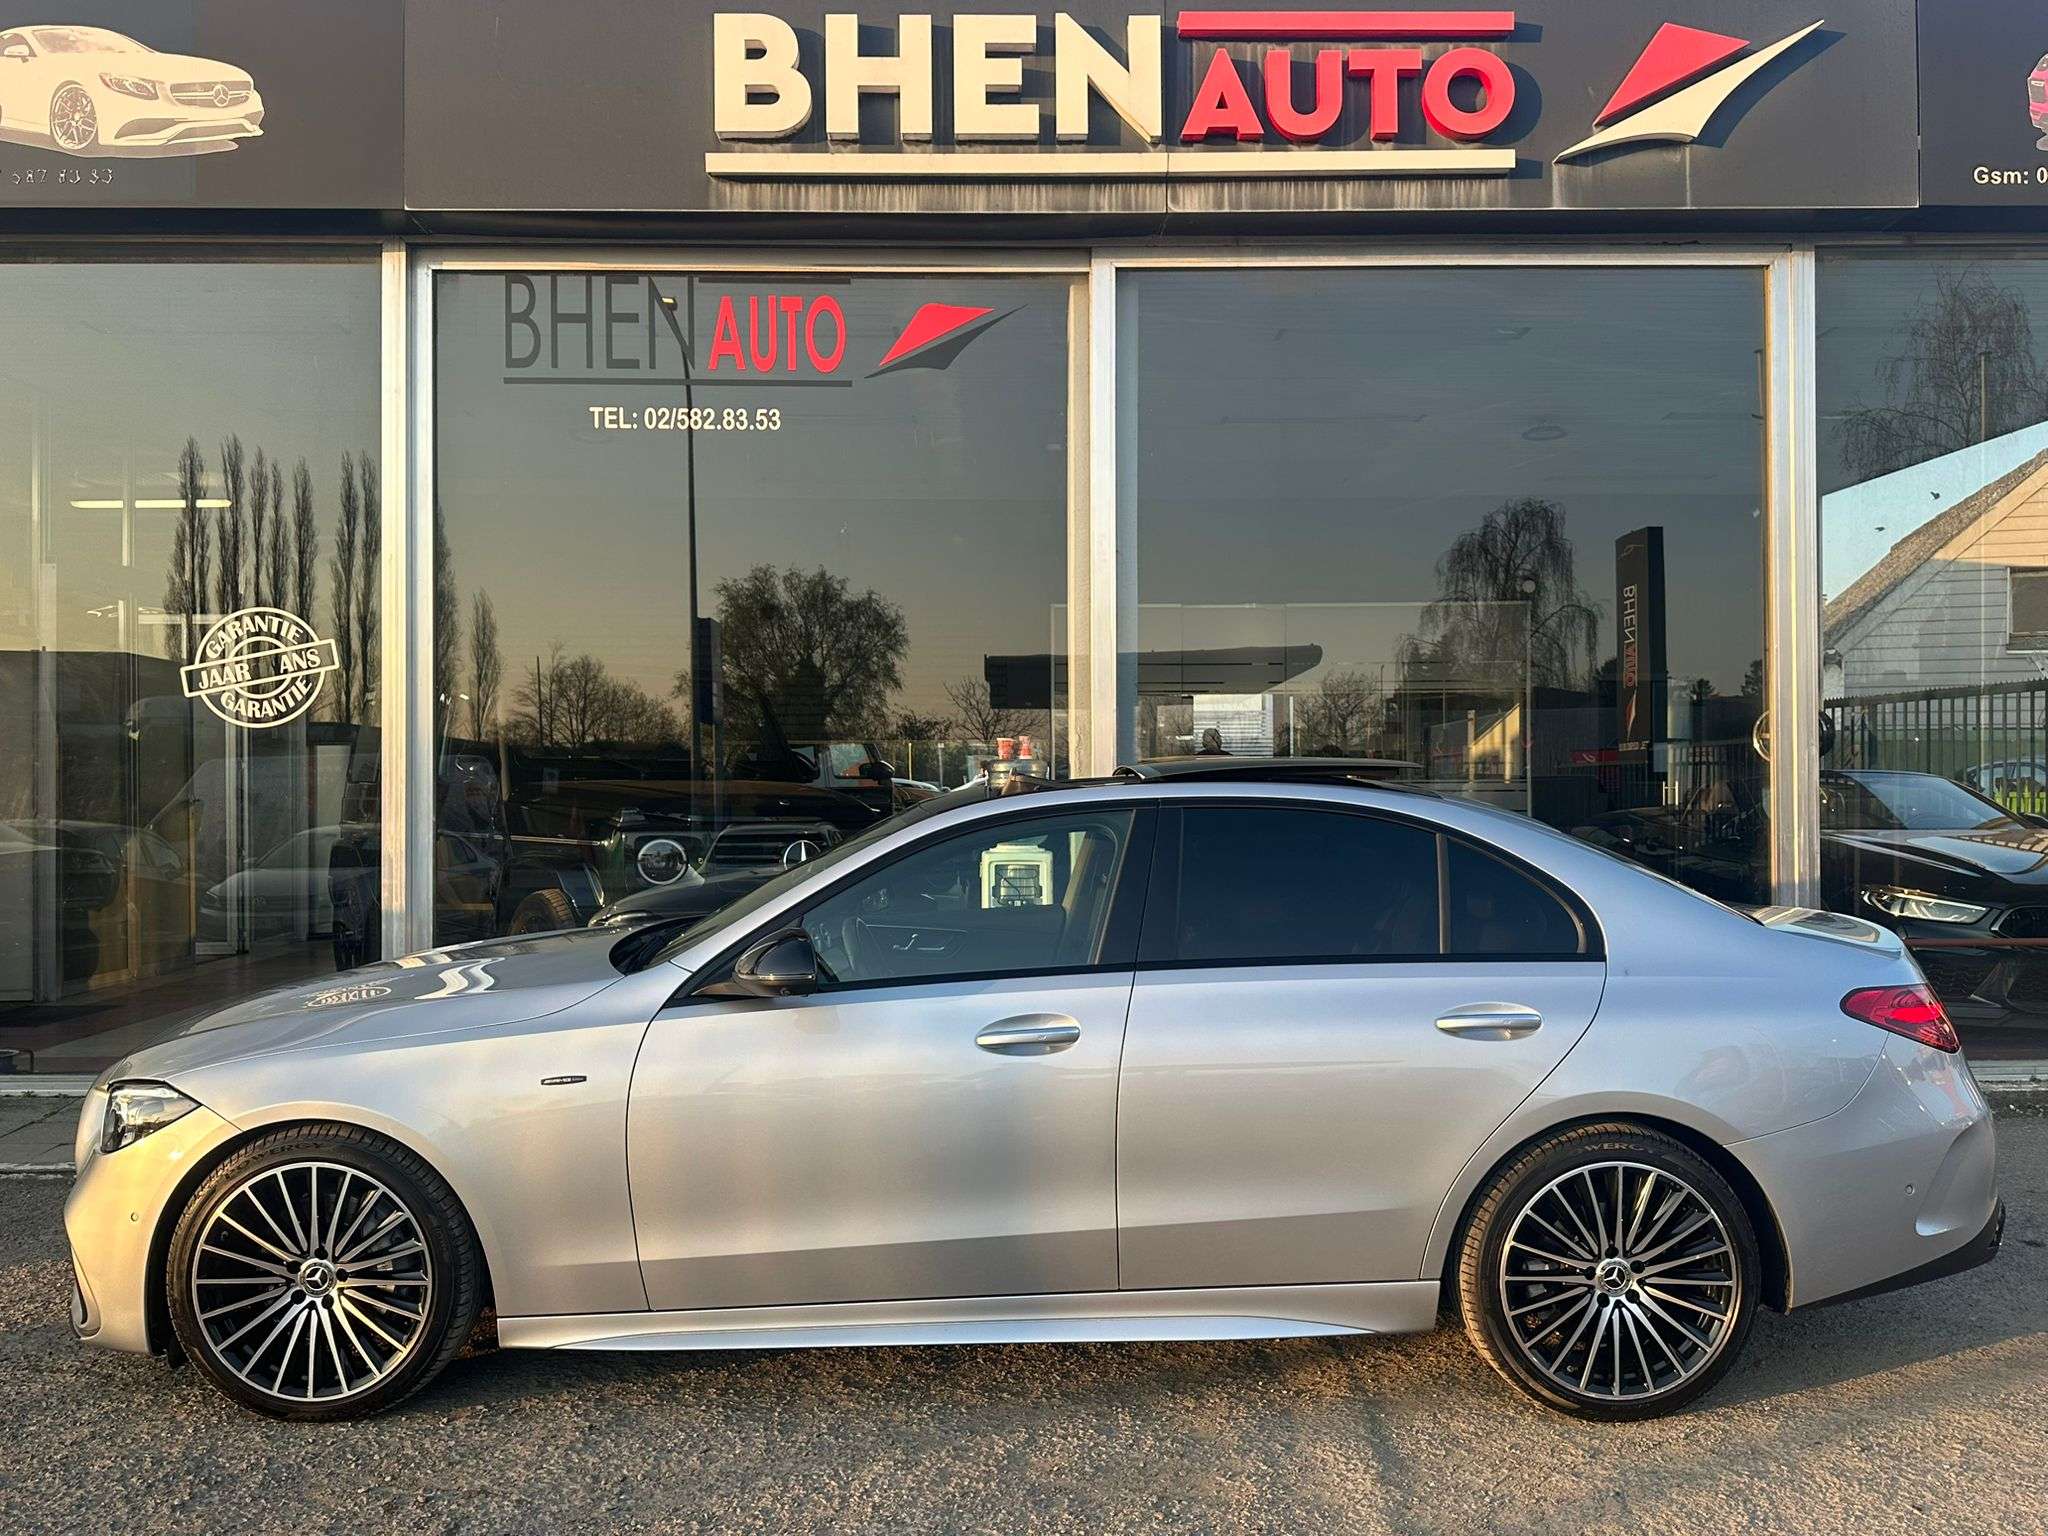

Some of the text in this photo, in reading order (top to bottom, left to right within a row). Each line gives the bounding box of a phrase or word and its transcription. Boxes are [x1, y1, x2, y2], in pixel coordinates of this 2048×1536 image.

[713, 13, 1515, 143] BHEN AUTO
[1974, 166, 2029, 185] Gsm:
[505, 274, 846, 374] BHEN AUTO
[589, 406, 781, 431] TEL: 02/582.83.53
[205, 615, 303, 658] GARANTIE
[199, 648, 321, 689] JAAR ANS
[220, 679, 312, 718] GARANTIE
